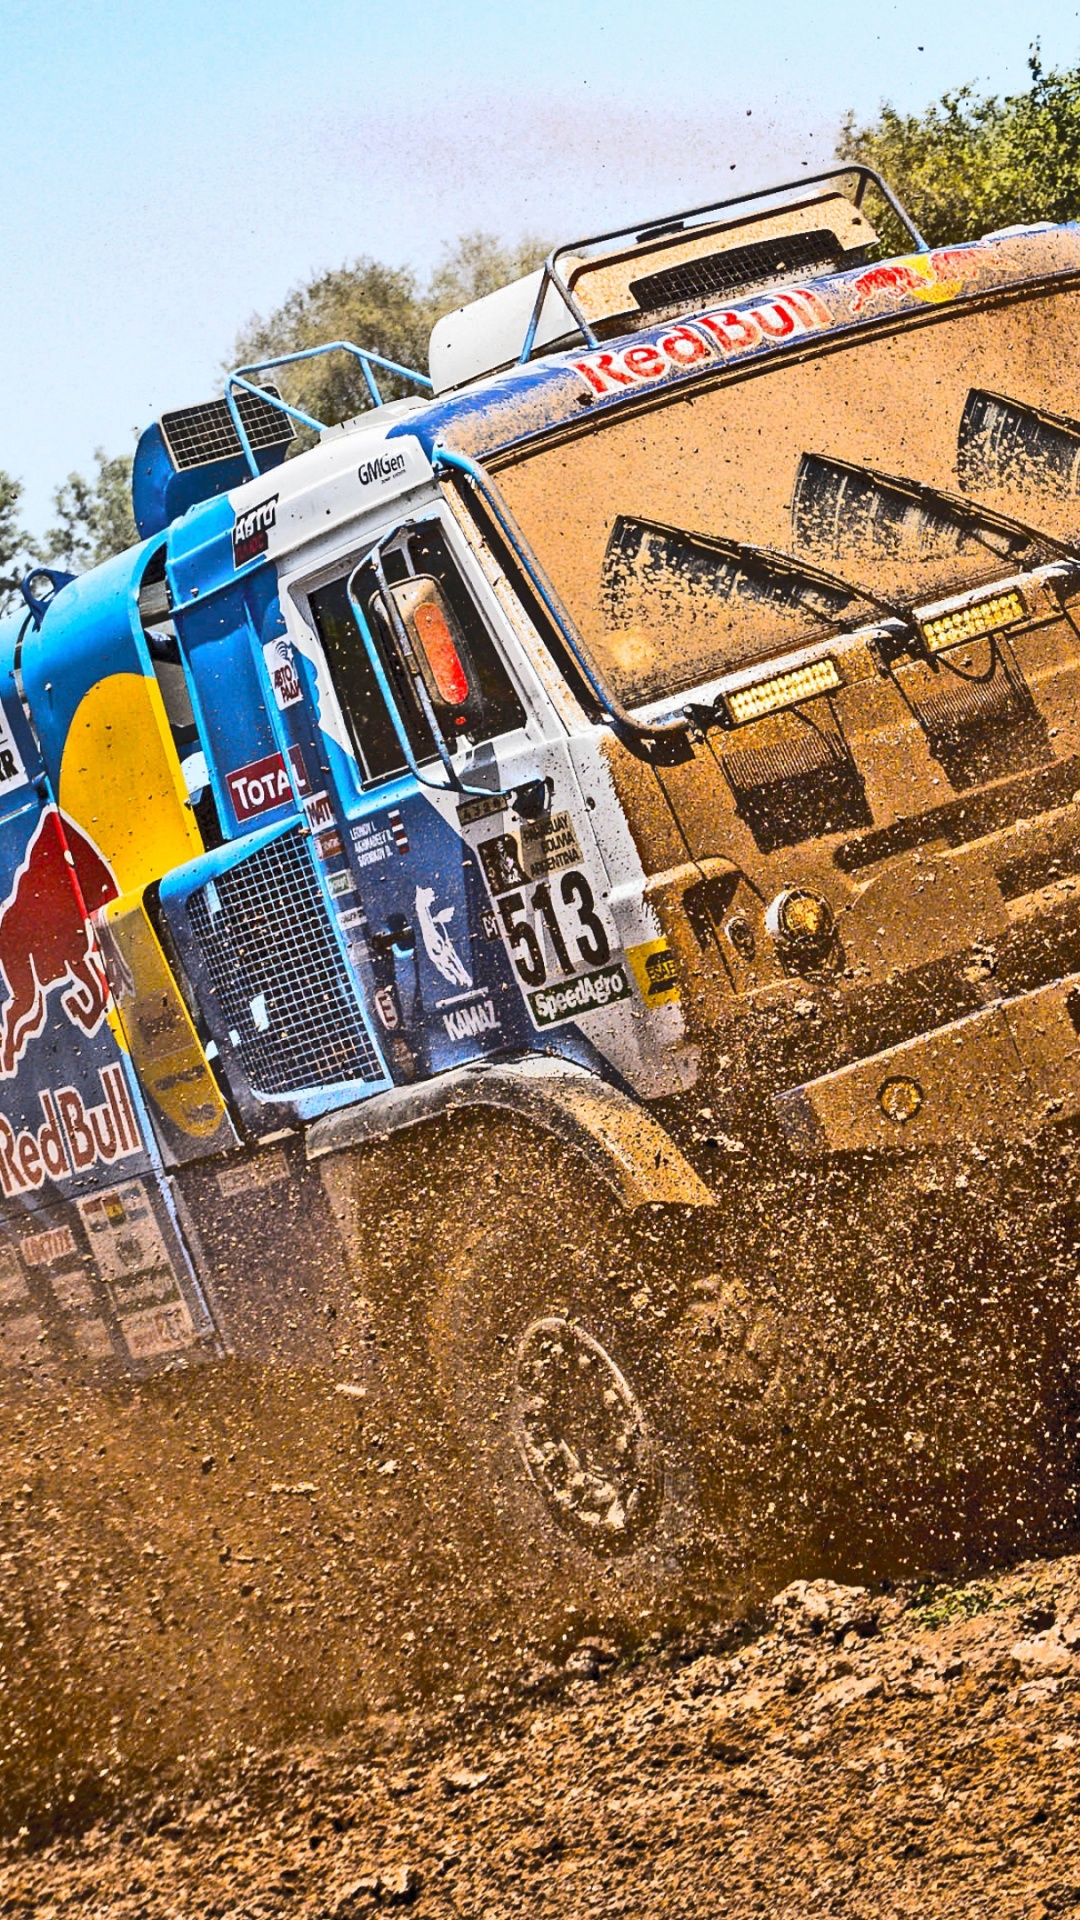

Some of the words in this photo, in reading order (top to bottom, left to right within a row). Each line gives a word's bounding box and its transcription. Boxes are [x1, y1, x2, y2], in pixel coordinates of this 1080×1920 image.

[572, 322, 715, 395] Red
[700, 288, 834, 353] Bull
[358, 453, 405, 486] GMGen
[231, 764, 307, 810] TOTAL
[496, 870, 611, 987] 513
[535, 972, 624, 1019] SpeedAgro
[442, 1000, 501, 1042] KAMAZ
[0, 1091, 71, 1195] Red
[56, 1065, 141, 1170] Bull
